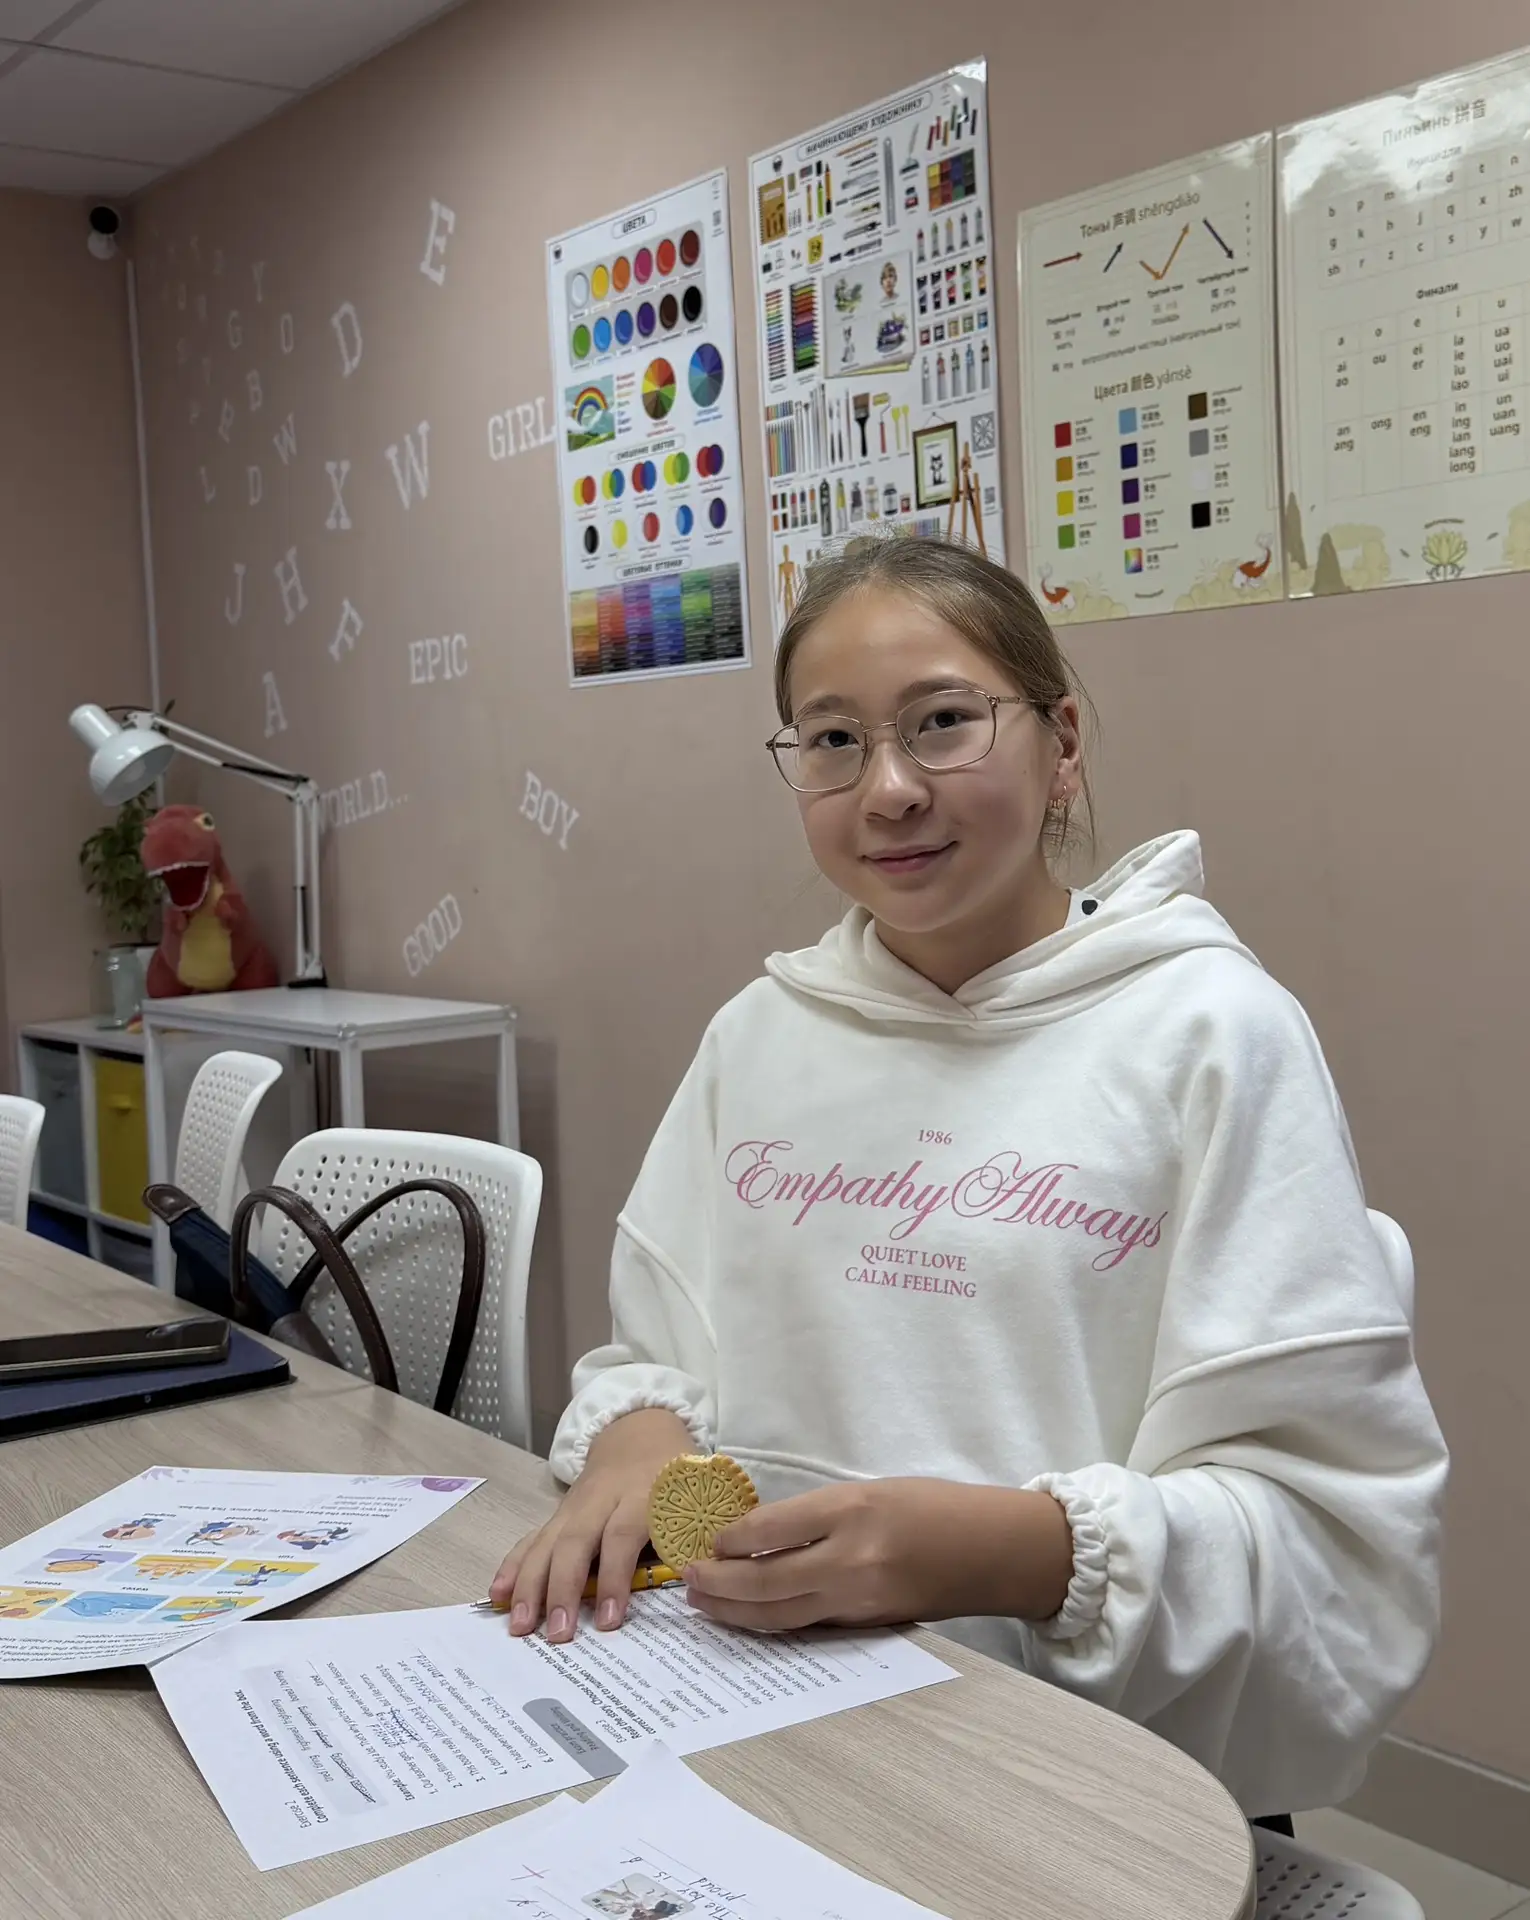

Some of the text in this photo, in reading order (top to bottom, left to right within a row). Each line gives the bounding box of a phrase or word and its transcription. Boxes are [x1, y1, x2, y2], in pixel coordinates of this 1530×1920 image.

[622, 215, 646, 233] ЦВЕТА
[420, 198, 455, 286] E
[331, 301, 363, 379] D
[1094, 380, 1128, 400] Цвета
[1337, 394, 1512, 436] an ong en in un
[487, 396, 557, 462] GIRL
[1334, 408, 1515, 451] ang eng ing uan
[384, 420, 430, 510] W
[325, 459, 352, 530] X
[224, 563, 246, 625] J
[273, 545, 310, 625] H
[408, 633, 469, 685] EPIC
[261, 671, 289, 738] A
[519, 768, 580, 851] BOY
[402, 892, 463, 978] GOOD
[917, 1128, 953, 1146] 1986
[724, 1140, 1169, 1272] Empathy Always
[861, 1244, 967, 1272] QUIET LOVE
[845, 1267, 977, 1298] CALM FEELING
[530, 1646, 550, 1657] box.
[540, 1655, 557, 1663] the
[554, 1651, 575, 1663] There
[547, 1662, 570, 1674] from
[561, 1672, 581, 1684] word
[575, 1669, 606, 1689] numbers
[238, 1700, 253, 1711] the
[576, 1686, 605, 1705] Choose
[604, 1694, 624, 1705] next
[243, 1710, 262, 1725] from
[596, 1703, 623, 1719] story.
[615, 1705, 638, 1718] word
[252, 1723, 271, 1738] word
[611, 1717, 629, 1727] the
[620, 1725, 643, 1739] Read
[631, 1716, 658, 1734] correct
[597, 1722, 628, 1743] Exercise
[264, 1741, 286, 1759] using
[276, 1757, 300, 1783] sentence
[292, 1782, 310, 1797] each
[287, 1803, 312, 1828] Exercise
[301, 1794, 331, 1823] Complete
[689, 1877, 746, 1902] proud
